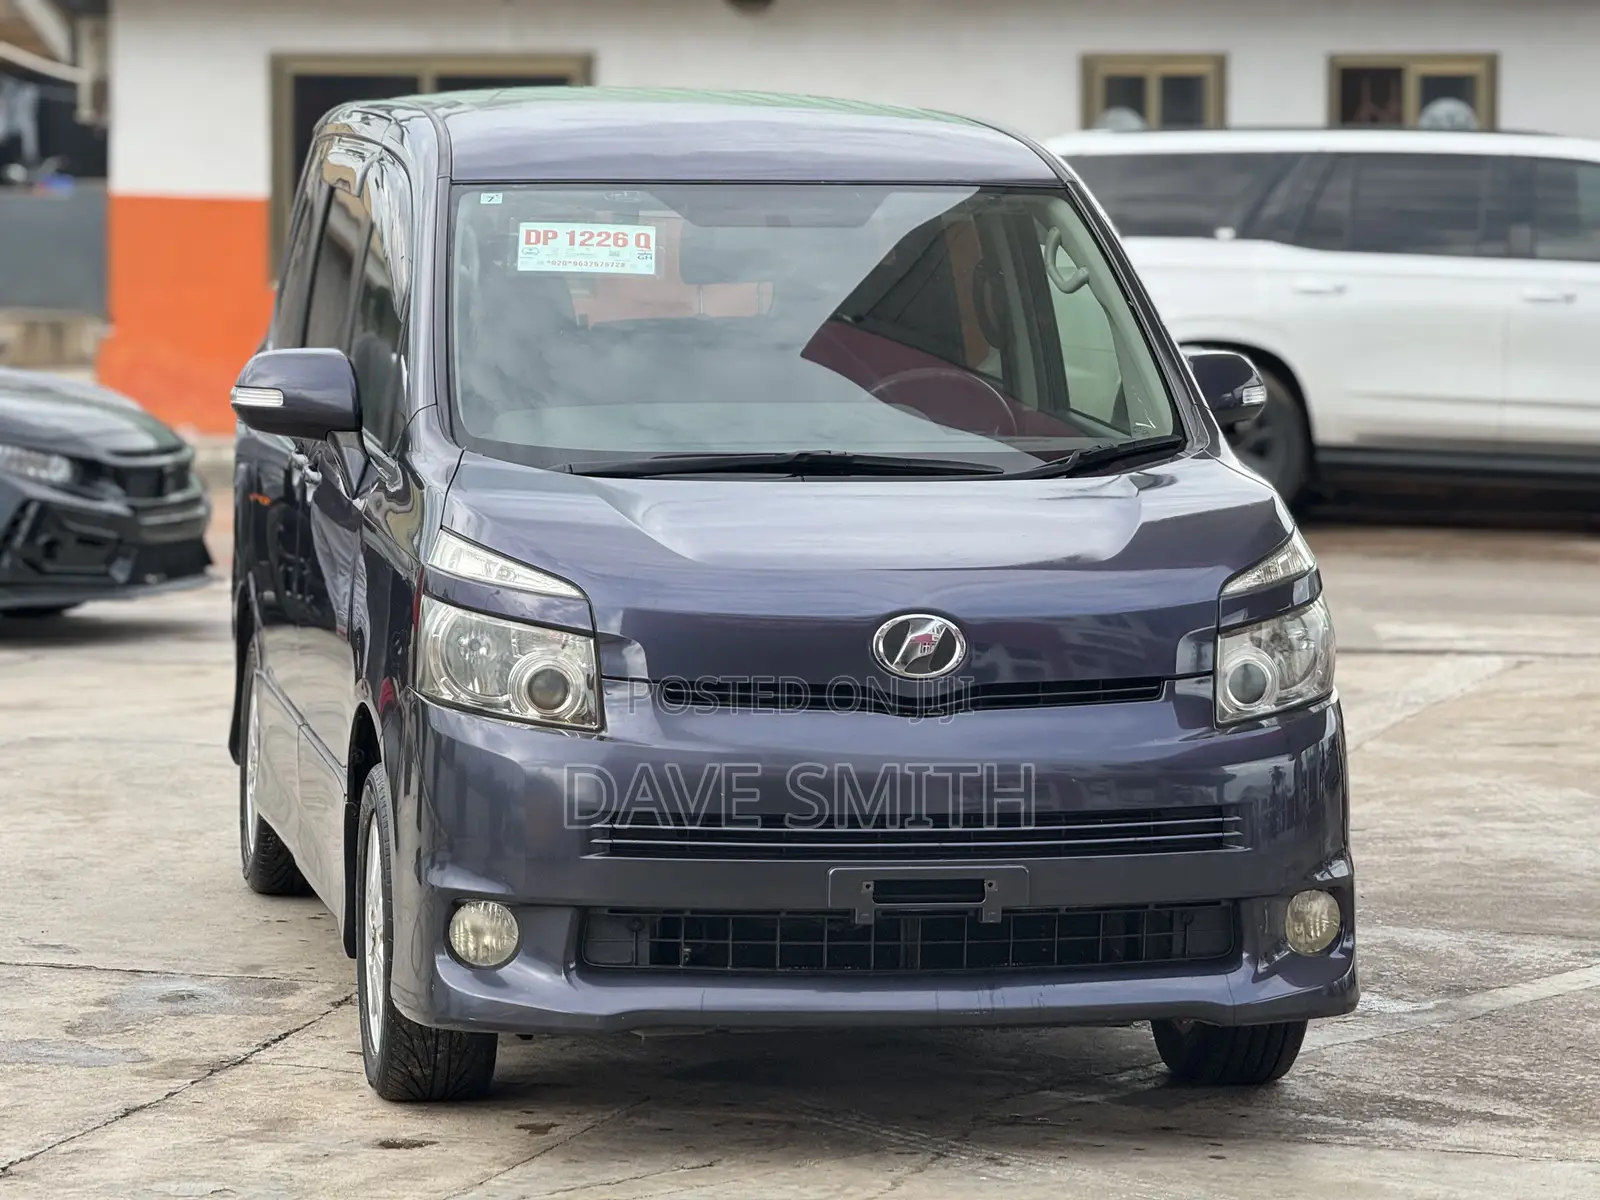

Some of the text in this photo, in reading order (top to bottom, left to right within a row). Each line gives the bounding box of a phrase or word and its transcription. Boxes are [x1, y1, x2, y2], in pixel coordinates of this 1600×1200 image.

[525, 229, 651, 250] DP 1226 Q
